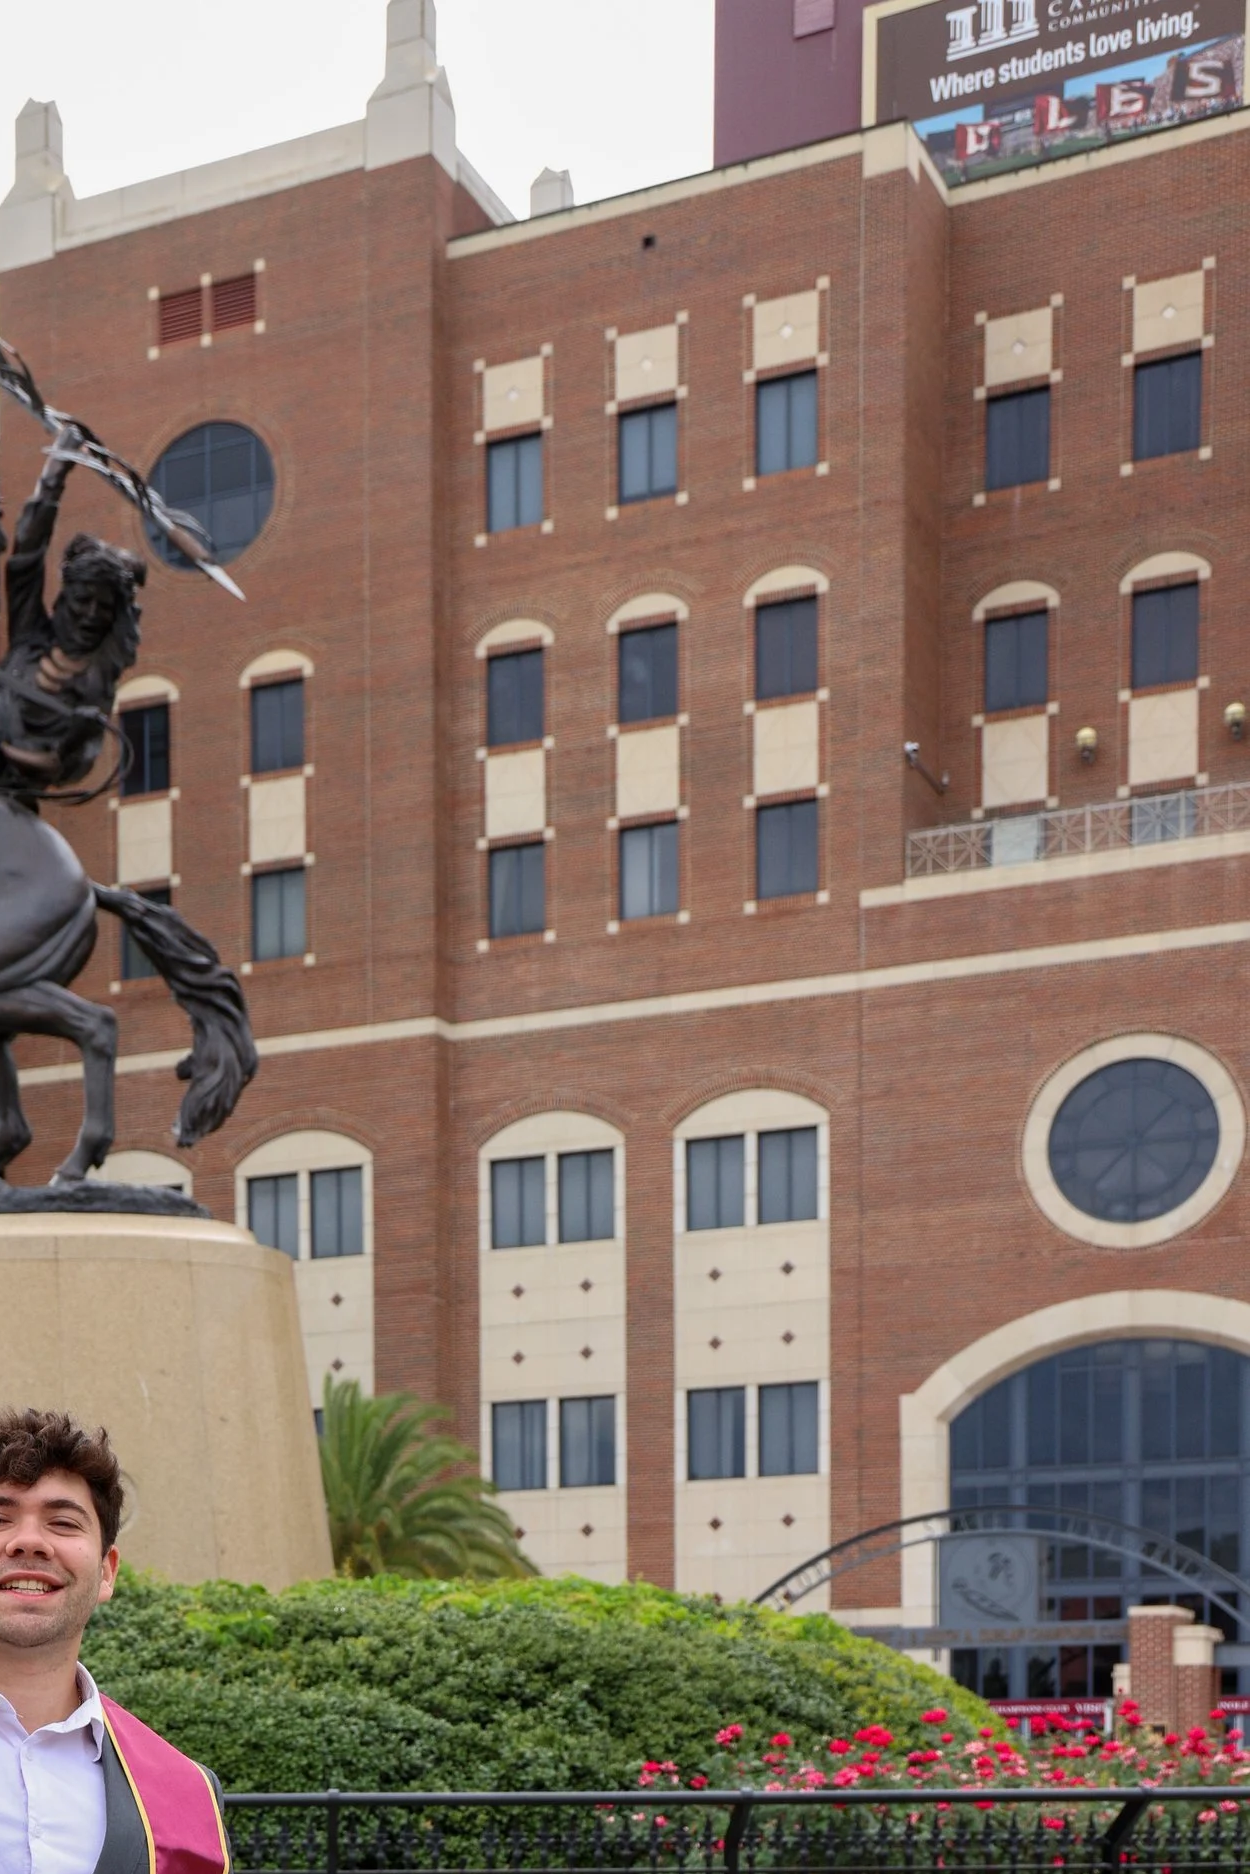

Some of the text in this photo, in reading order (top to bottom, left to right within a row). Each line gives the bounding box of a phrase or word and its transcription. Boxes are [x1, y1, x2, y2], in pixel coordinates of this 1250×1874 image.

[929, 11, 1200, 103] Where students love living.
